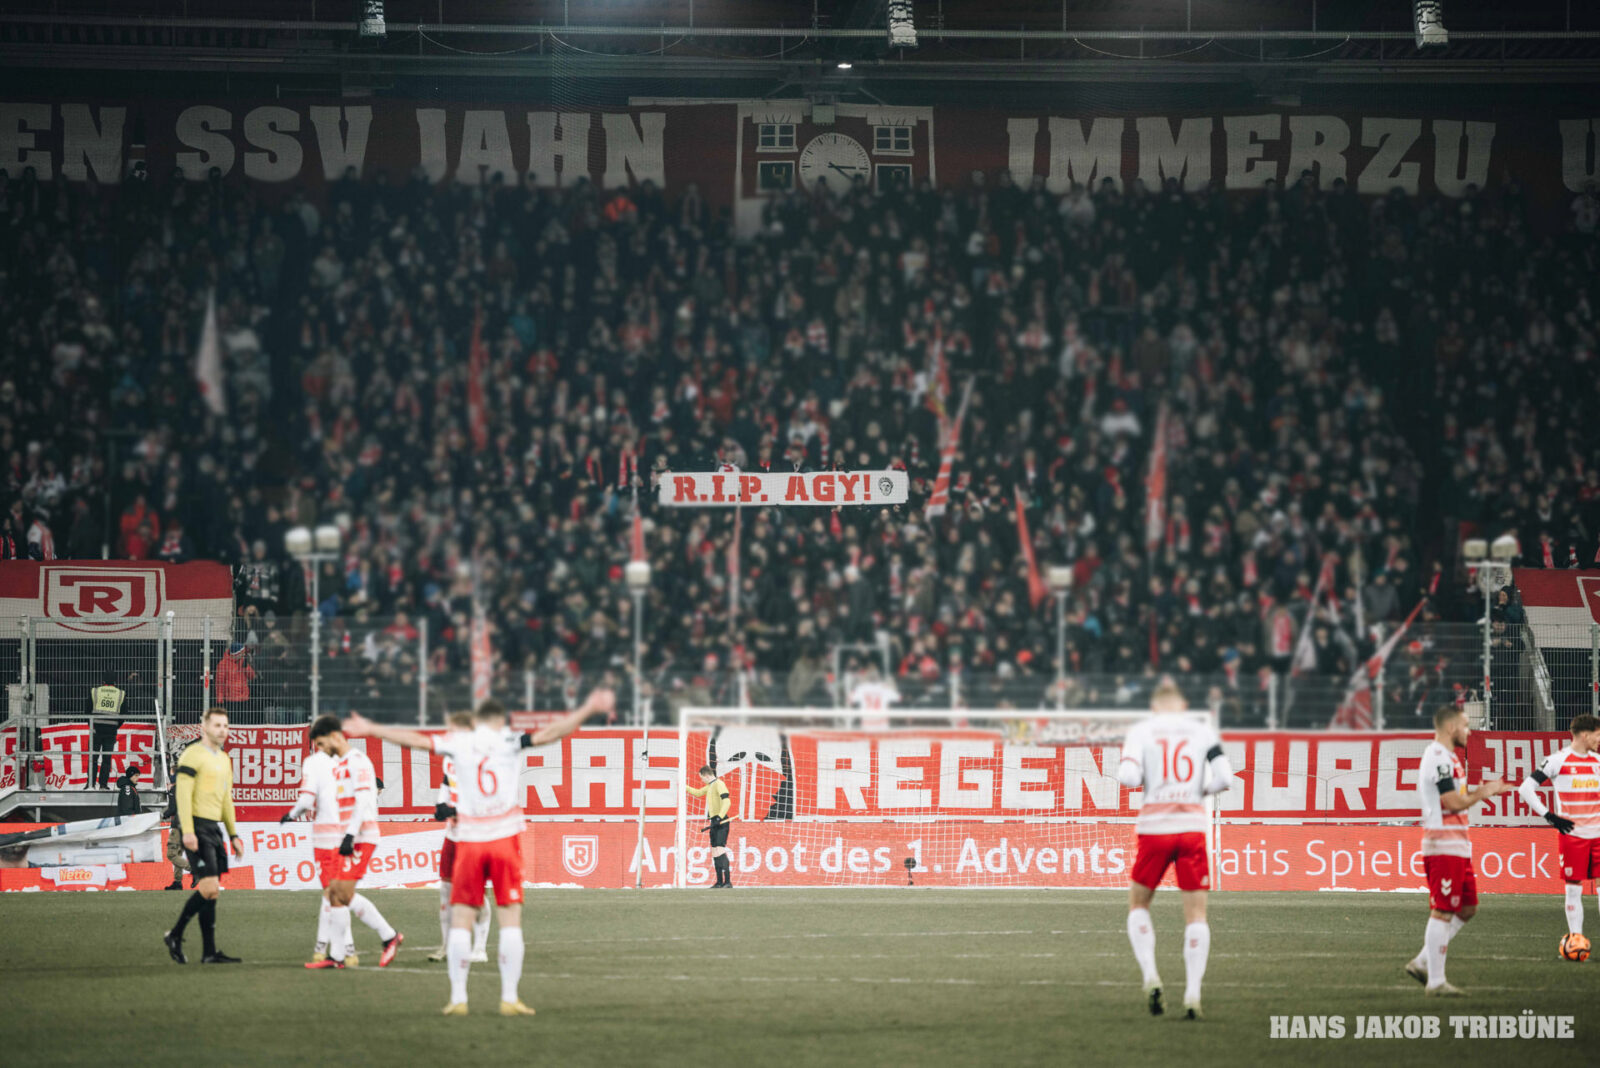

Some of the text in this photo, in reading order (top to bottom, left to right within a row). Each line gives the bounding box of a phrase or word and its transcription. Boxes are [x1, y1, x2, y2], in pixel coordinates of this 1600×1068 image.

[176, 105, 373, 183] SSV
[1007, 114, 1496, 195] IMMERZU
[673, 474, 871, 501] R.I.P. AGY!
[101, 700, 115, 708] 680
[228, 730, 302, 746] SSV JAHN
[229, 748, 302, 784] 1889
[1155, 738, 1194, 783] 16
[477, 756, 498, 797] 6
[252, 830, 306, 852] Fan-
[820, 837, 892, 873] des
[956, 837, 1125, 874] Advents
[59, 869, 93, 881] Netto
[268, 864, 288, 886] &
